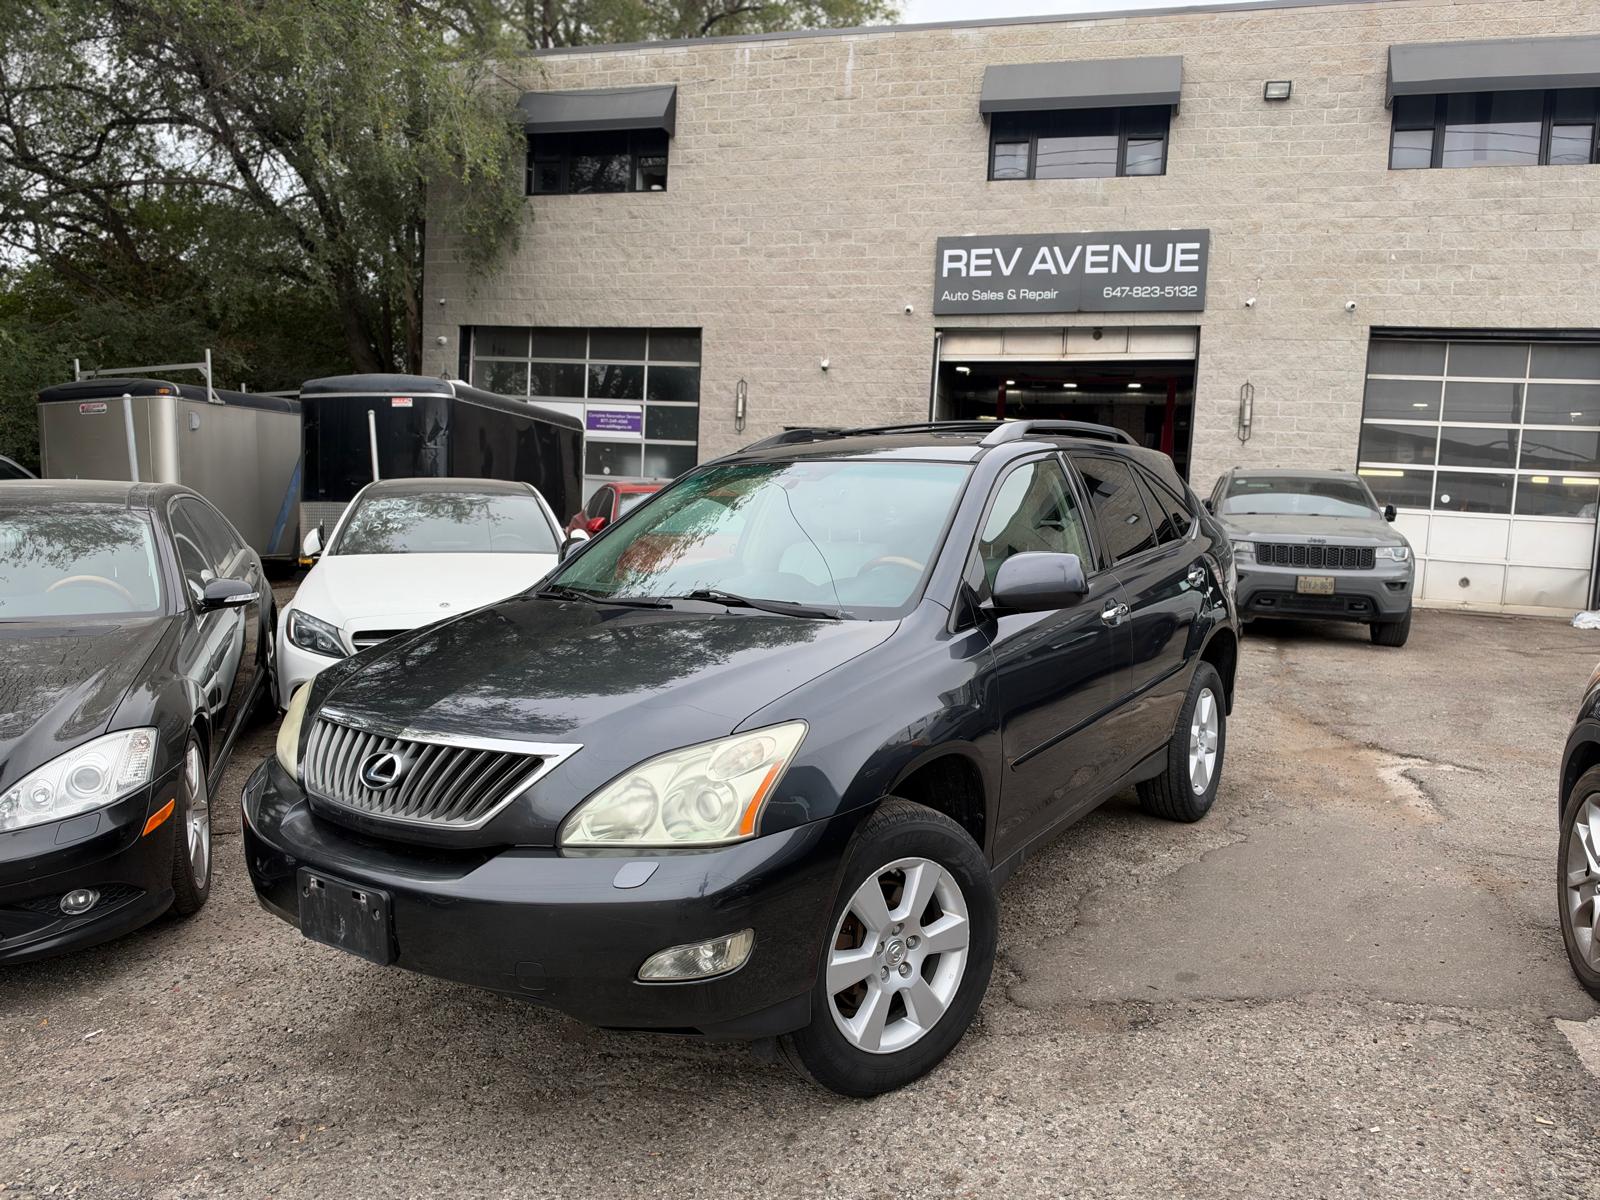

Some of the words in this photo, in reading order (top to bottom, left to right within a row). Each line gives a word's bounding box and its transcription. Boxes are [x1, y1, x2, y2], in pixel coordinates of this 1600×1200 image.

[942, 247, 1023, 277] REV
[1028, 243, 1200, 275] AVENUE
[941, 290, 969, 301] Auto
[972, 290, 1004, 300] Sales
[1007, 289, 1017, 300] &
[1020, 288, 1059, 302] Repair
[1103, 285, 1198, 298] 647-823-5132
